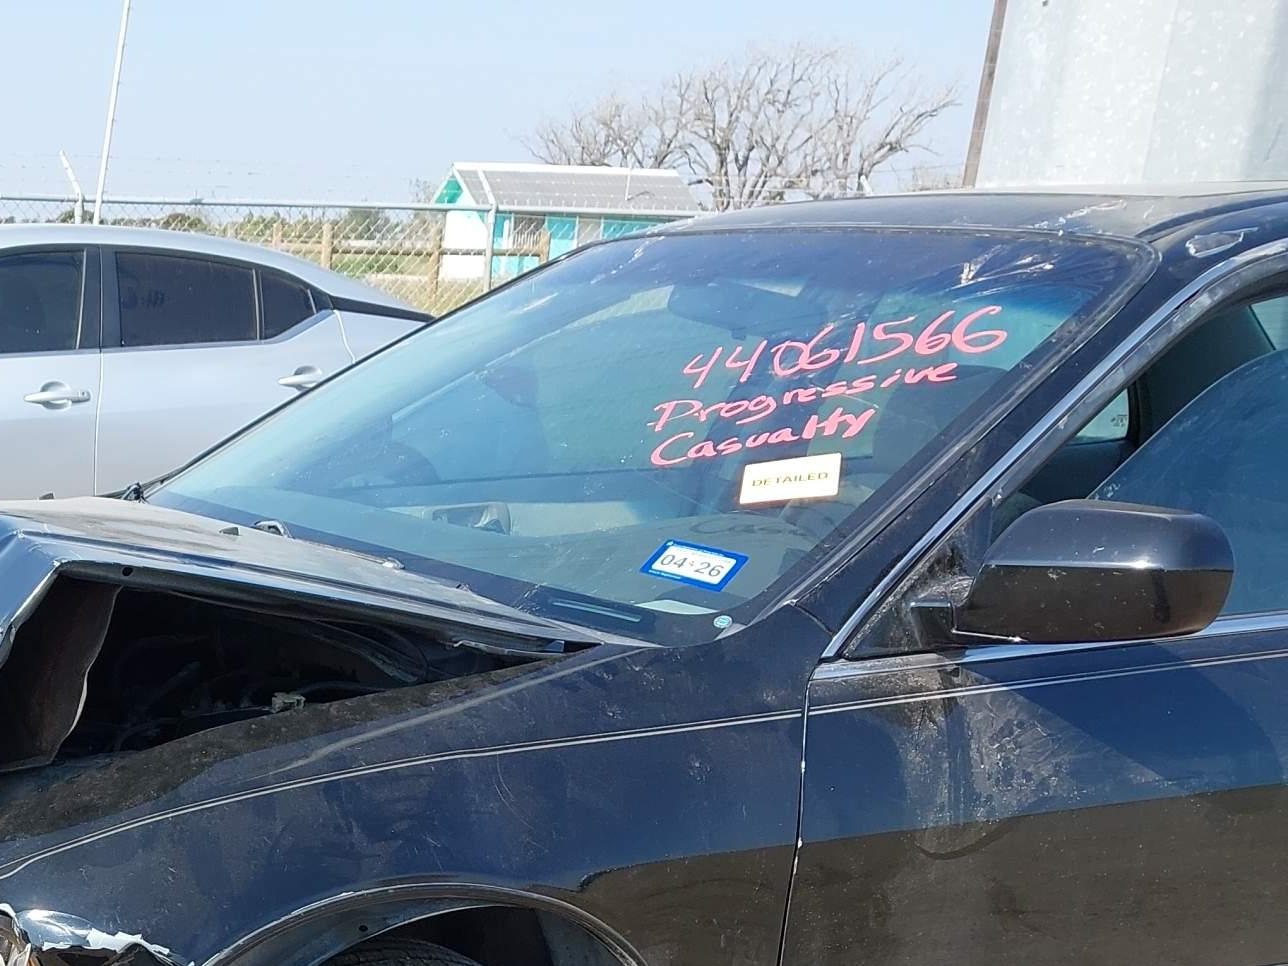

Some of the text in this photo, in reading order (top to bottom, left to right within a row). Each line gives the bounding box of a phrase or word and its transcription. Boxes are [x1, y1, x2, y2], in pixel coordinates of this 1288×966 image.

[682, 305, 1008, 389] 44061566
[648, 361, 958, 433] Progressive
[650, 407, 879, 466] Casualty
[752, 472, 829, 487] DETAILED
